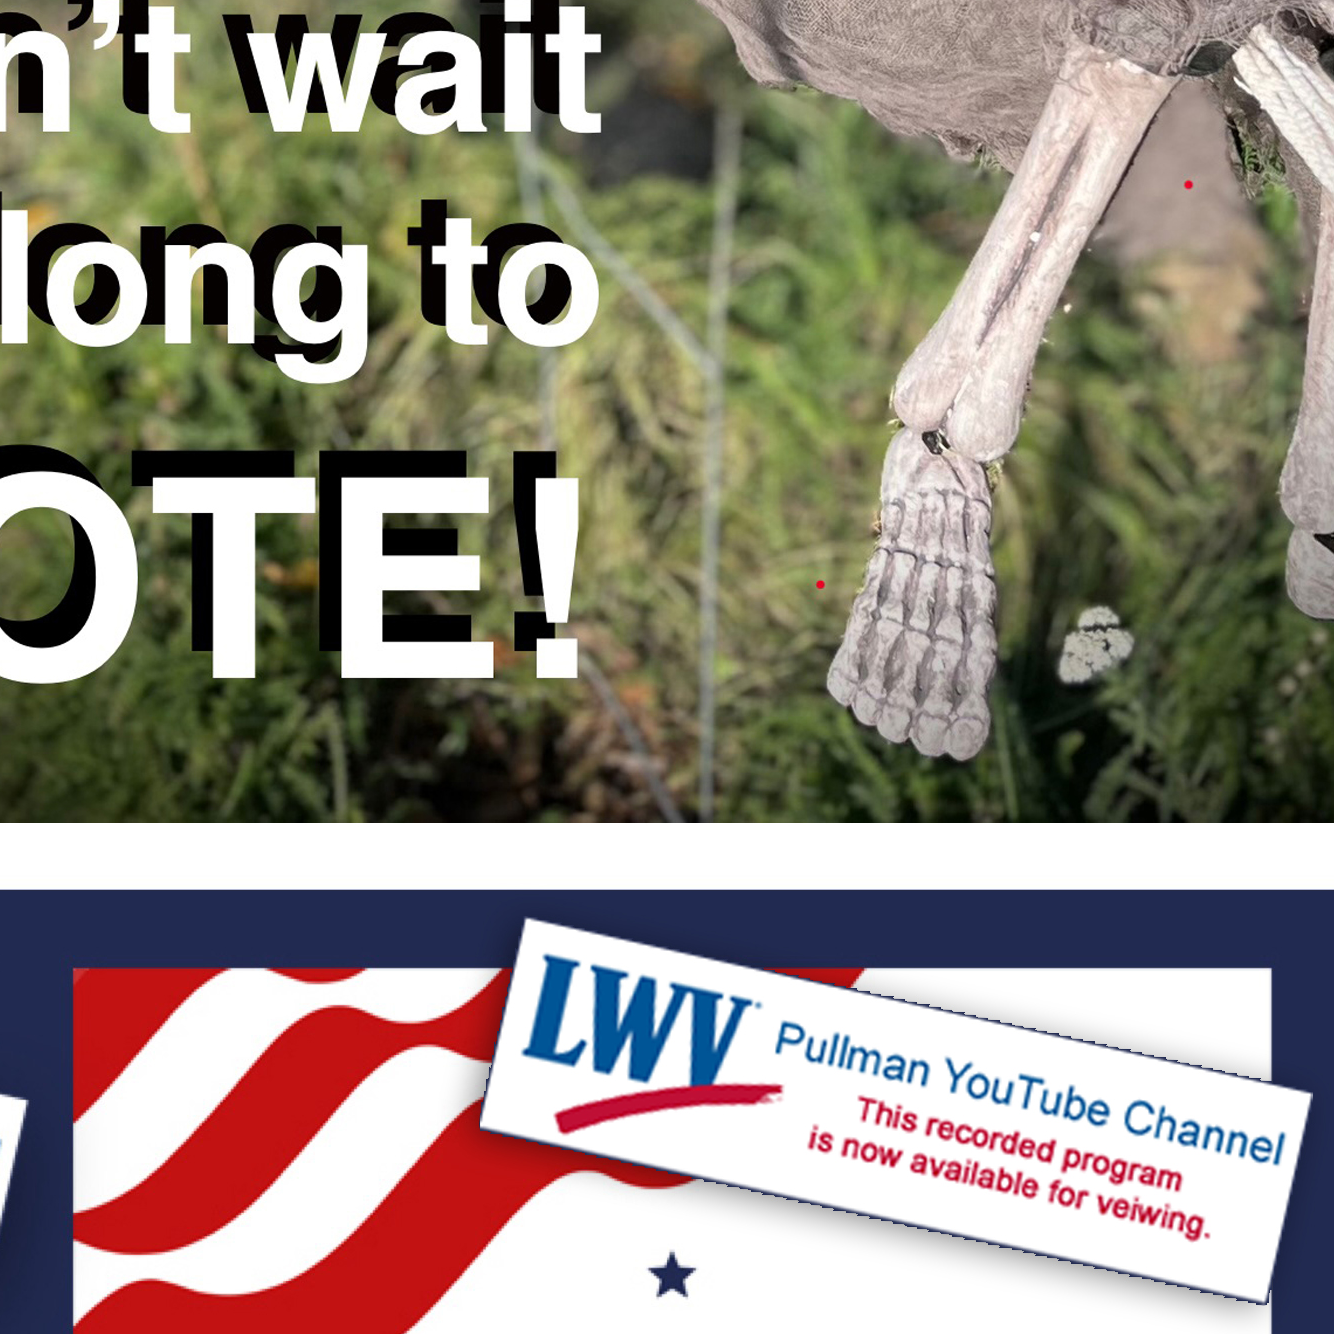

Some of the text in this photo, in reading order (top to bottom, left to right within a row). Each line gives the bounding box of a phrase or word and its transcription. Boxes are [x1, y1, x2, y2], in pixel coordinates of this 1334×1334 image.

[522, 955, 752, 1085] LWV
[776, 1022, 1285, 1165] Pullman YouTube Channel
